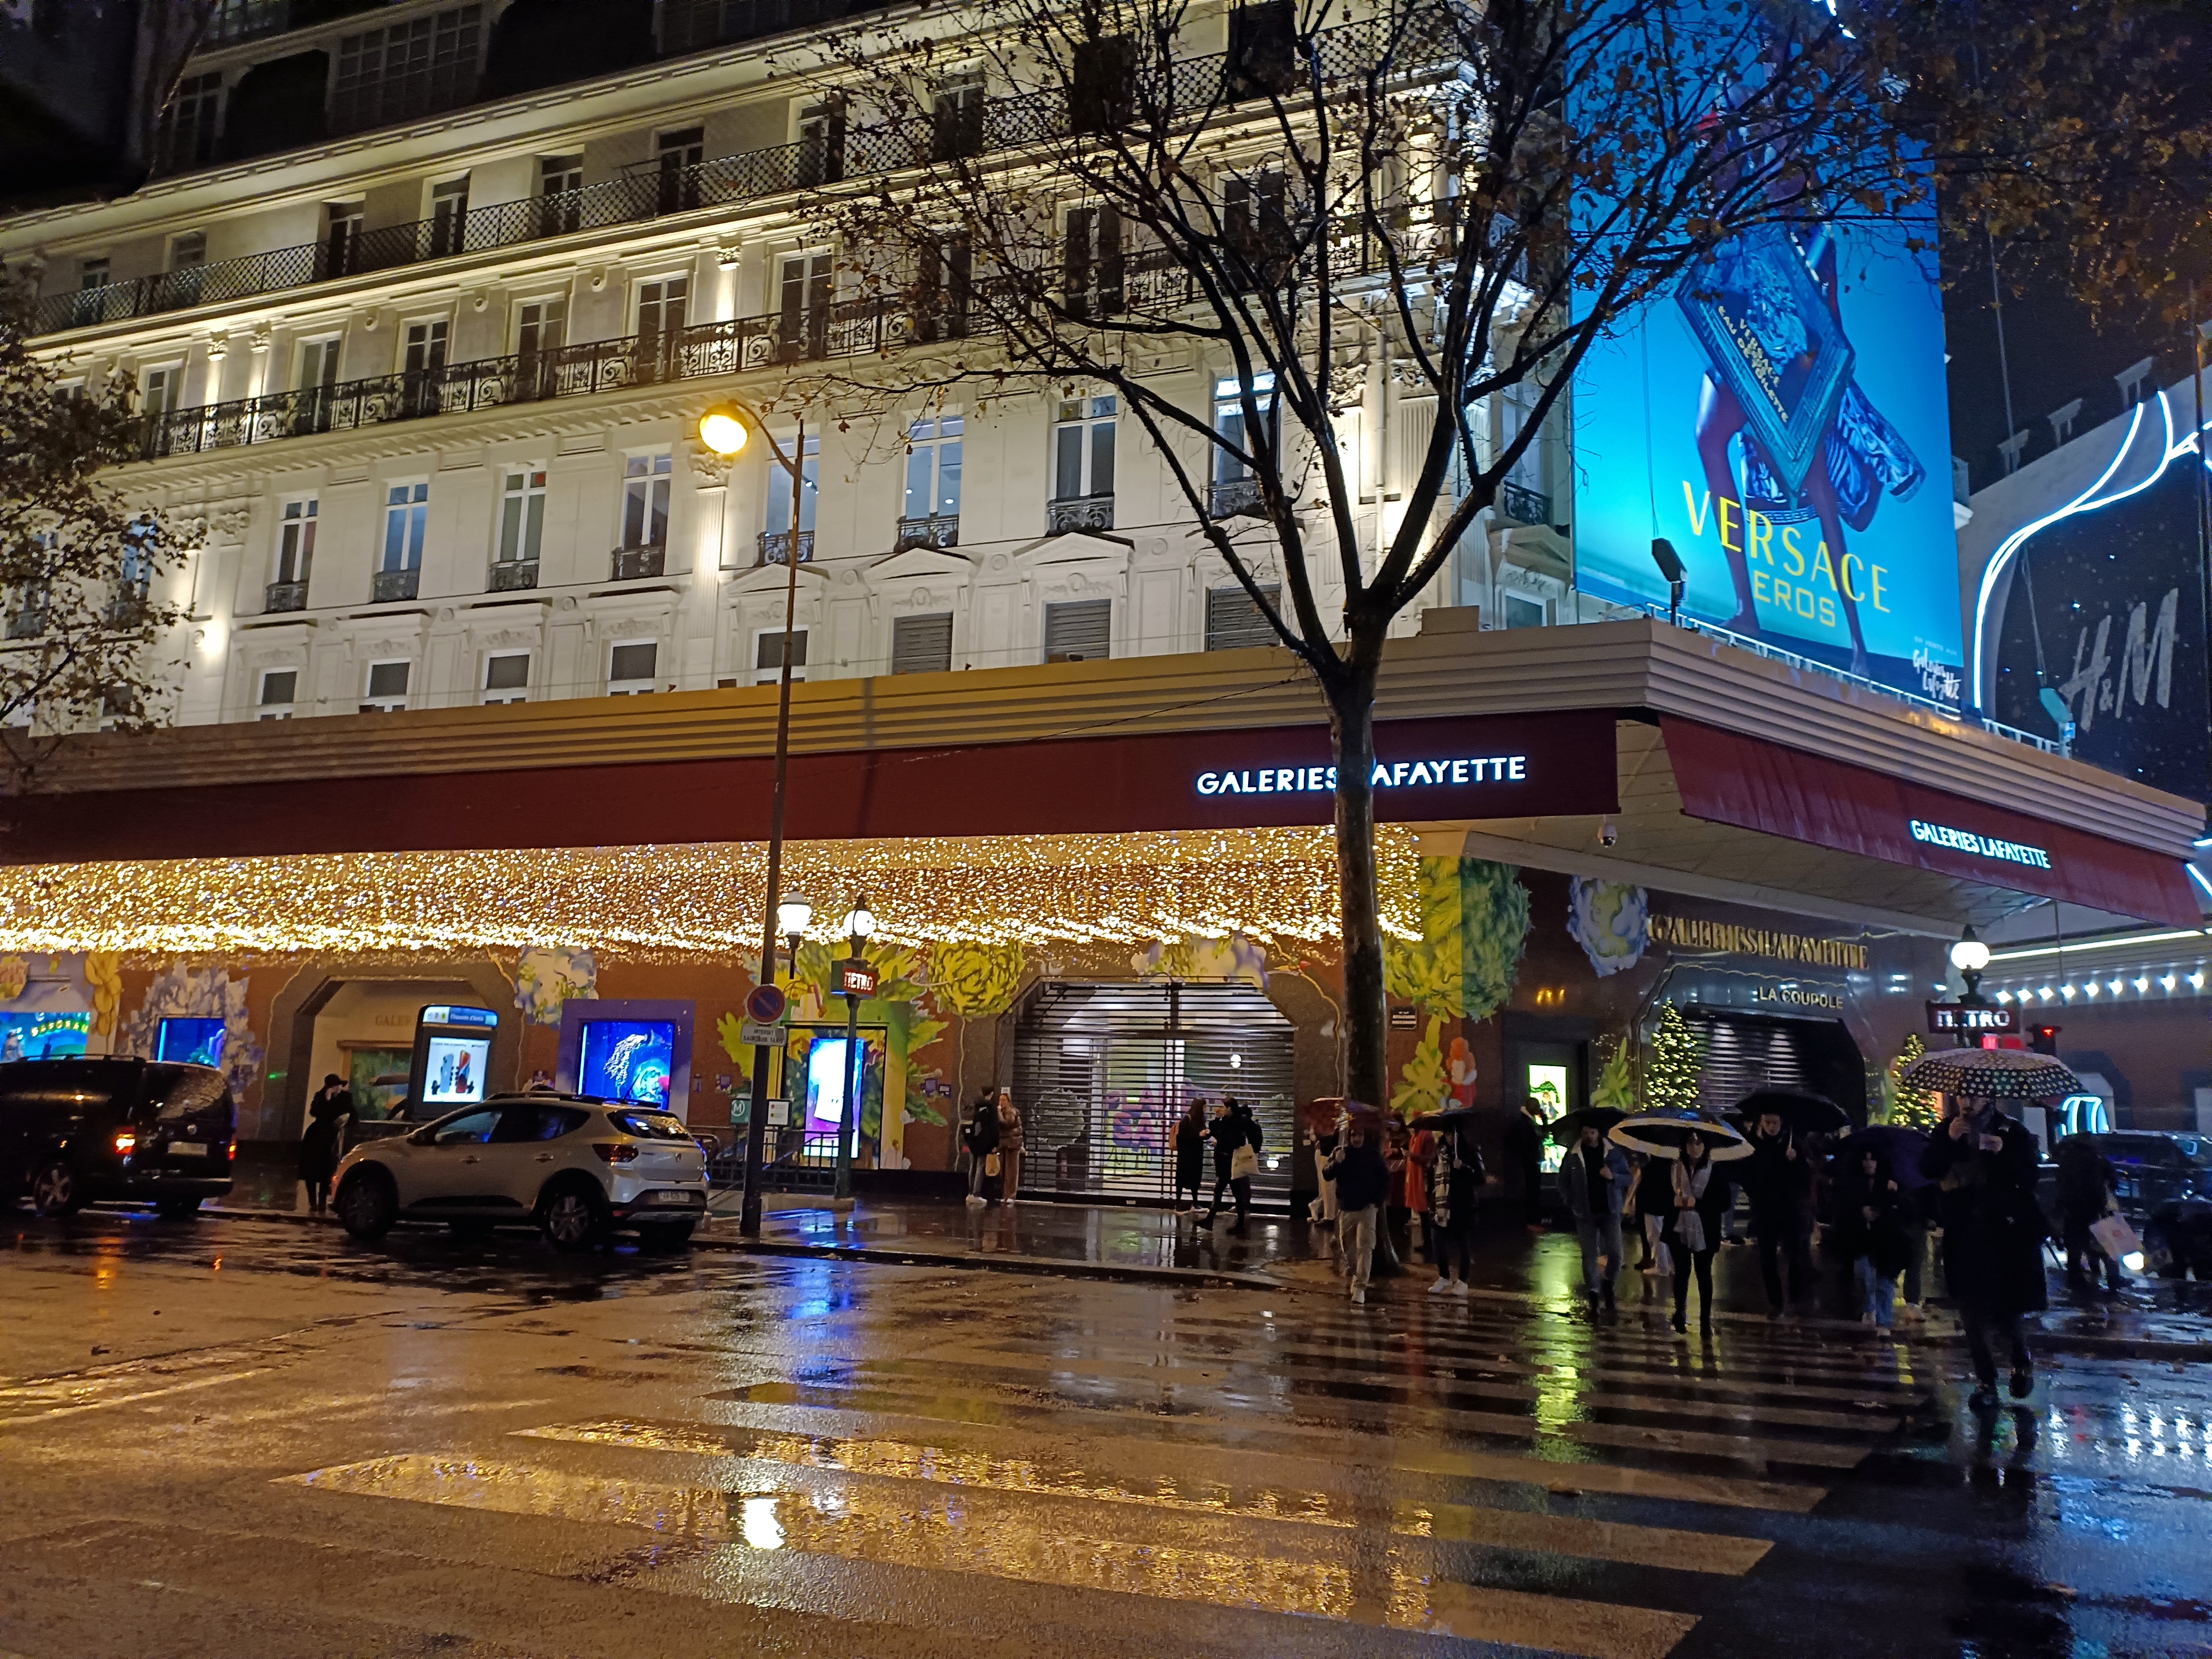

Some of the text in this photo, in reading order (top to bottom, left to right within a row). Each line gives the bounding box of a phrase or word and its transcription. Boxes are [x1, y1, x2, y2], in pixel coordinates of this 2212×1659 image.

[1683, 481, 1890, 613] VERSACE
[1754, 570, 1835, 627] EROS
[2058, 587, 2178, 733] H&M
[1197, 756, 1526, 794] GALERIES AFAYETTE
[1910, 820, 2052, 869] GALERIES LAFAYETTE
[1647, 914, 1870, 970] GALERIES LAFAYETTE
[1759, 986, 1843, 1010] LA COUPOLE
[1936, 1010, 2010, 1027] MTRO
